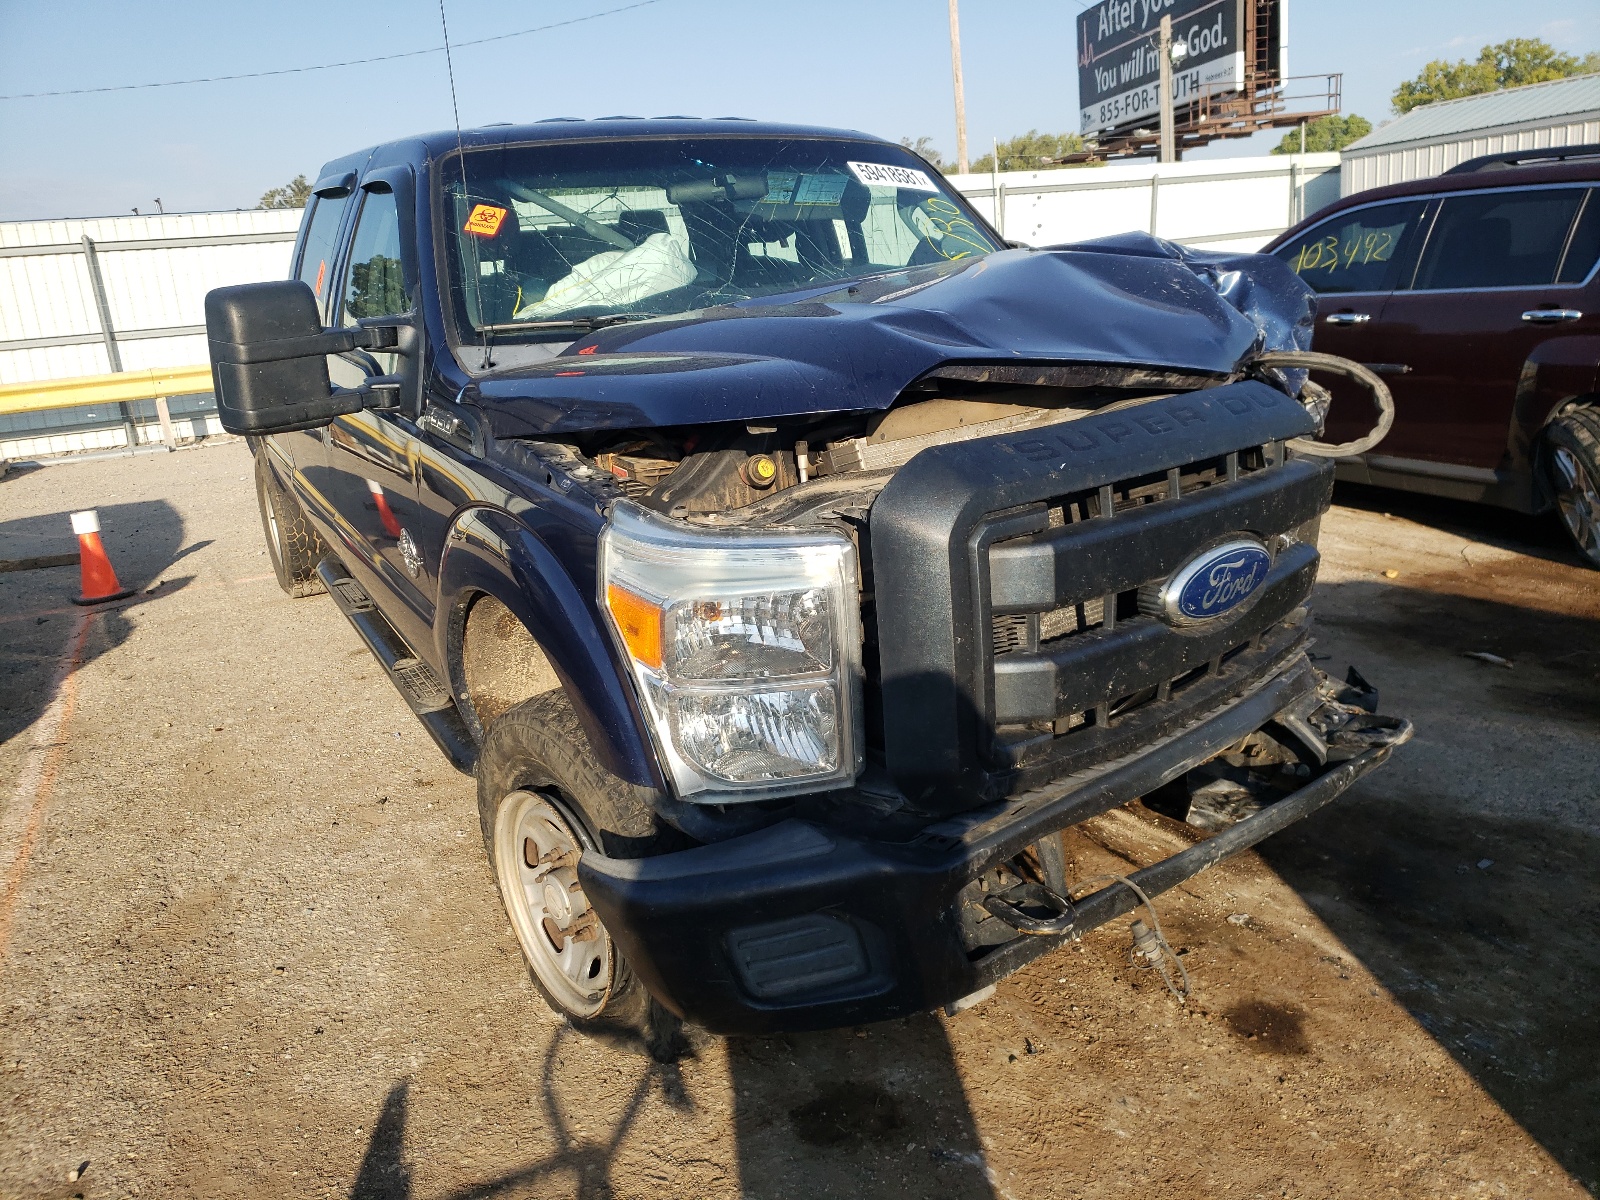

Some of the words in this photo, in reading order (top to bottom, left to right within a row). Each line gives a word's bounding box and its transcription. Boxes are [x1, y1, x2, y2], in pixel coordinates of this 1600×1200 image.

[1098, 0, 1136, 41] After
[1095, 66, 1118, 94] You
[1120, 47, 1145, 84] will
[1187, 12, 1227, 57] God.
[1100, 70, 1200, 124] 855-FOR-TUTH
[856, 163, 924, 186] 59418581
[1296, 232, 1393, 275] 103,492
[1012, 405, 1206, 462] SUPER
[1202, 557, 1258, 610] Ford
